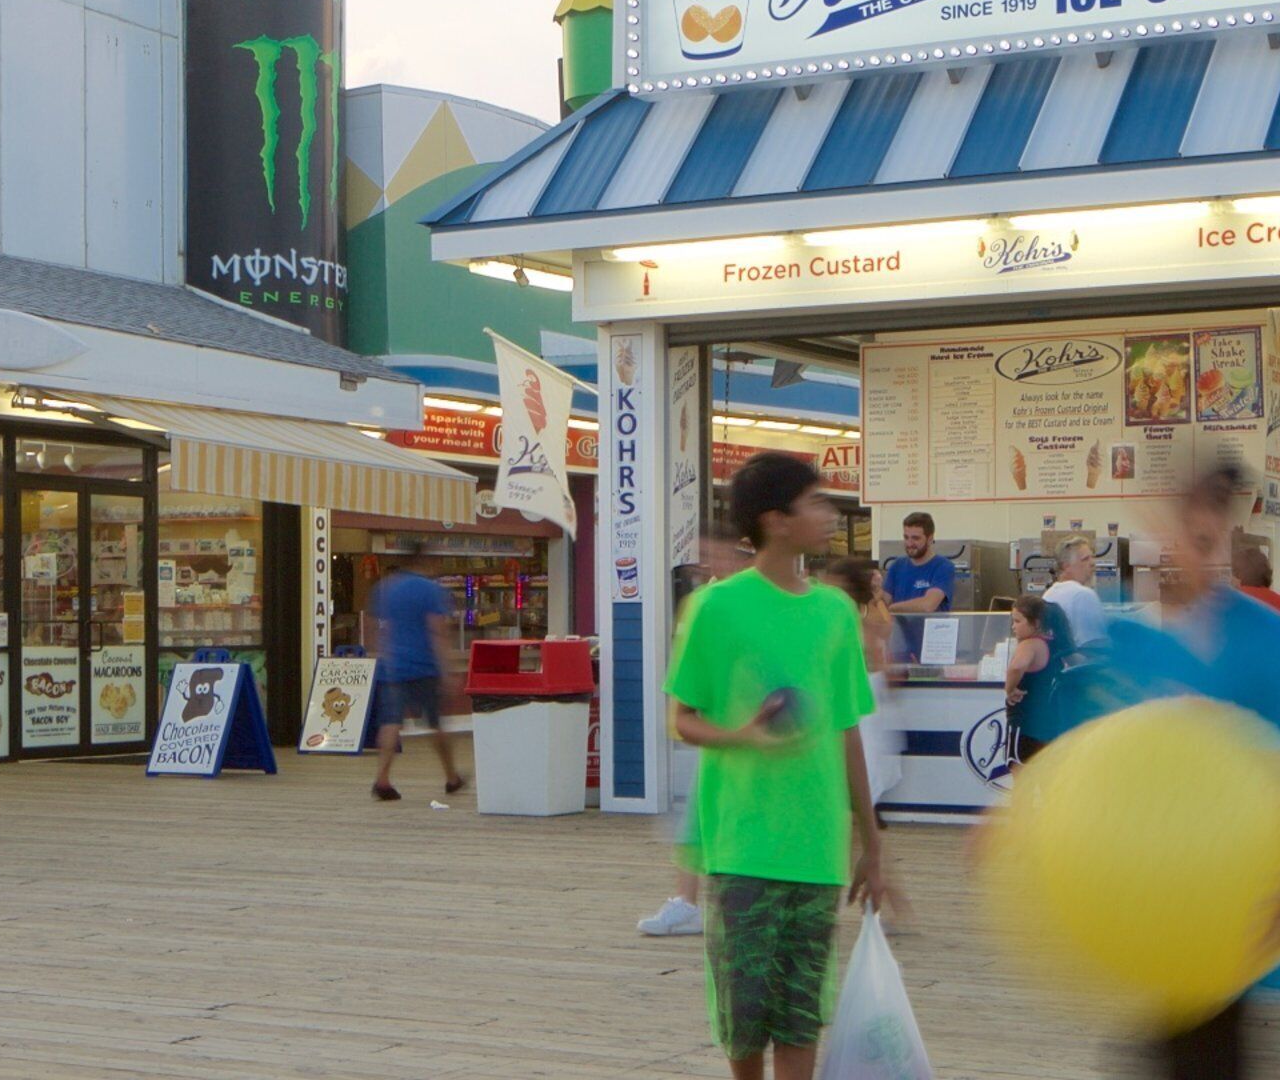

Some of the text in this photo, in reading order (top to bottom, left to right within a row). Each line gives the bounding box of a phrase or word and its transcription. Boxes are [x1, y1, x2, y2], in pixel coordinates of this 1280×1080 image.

[941, 1, 993, 21] SINCE
[1198, 227, 1236, 248] Ice
[983, 235, 1063, 269] Kohr's
[723, 251, 901, 283] Frozen Custard
[239, 290, 344, 312] ENERGY
[1213, 338, 1232, 347] Take
[1014, 341, 1100, 373] Kohr's
[1211, 347, 1245, 359] Shake
[1020, 391, 1103, 404] Always look for the name
[1056, 405, 1082, 413] Custard
[1083, 403, 1109, 414] Original
[430, 413, 485, 429] sparkling
[1005, 420, 1014, 429] for
[1015, 420, 1026, 428] the
[1027, 419, 1042, 428] BEST
[1043, 418, 1068, 428] Custard
[1069, 417, 1081, 426] and
[460, 427, 485, 438] with
[413, 435, 485, 449] your meal at
[615, 530, 639, 540] Since
[618, 538, 637, 549] 1919
[93, 665, 142, 679] MACAROONS
[320, 669, 368, 678] CARAMEL
[32, 677, 67, 695] BACON
[319, 674, 368, 686] POPCORN
[162, 722, 221, 743] Chocolate
[160, 733, 219, 751] COVERED
[156, 743, 216, 767] BACON
